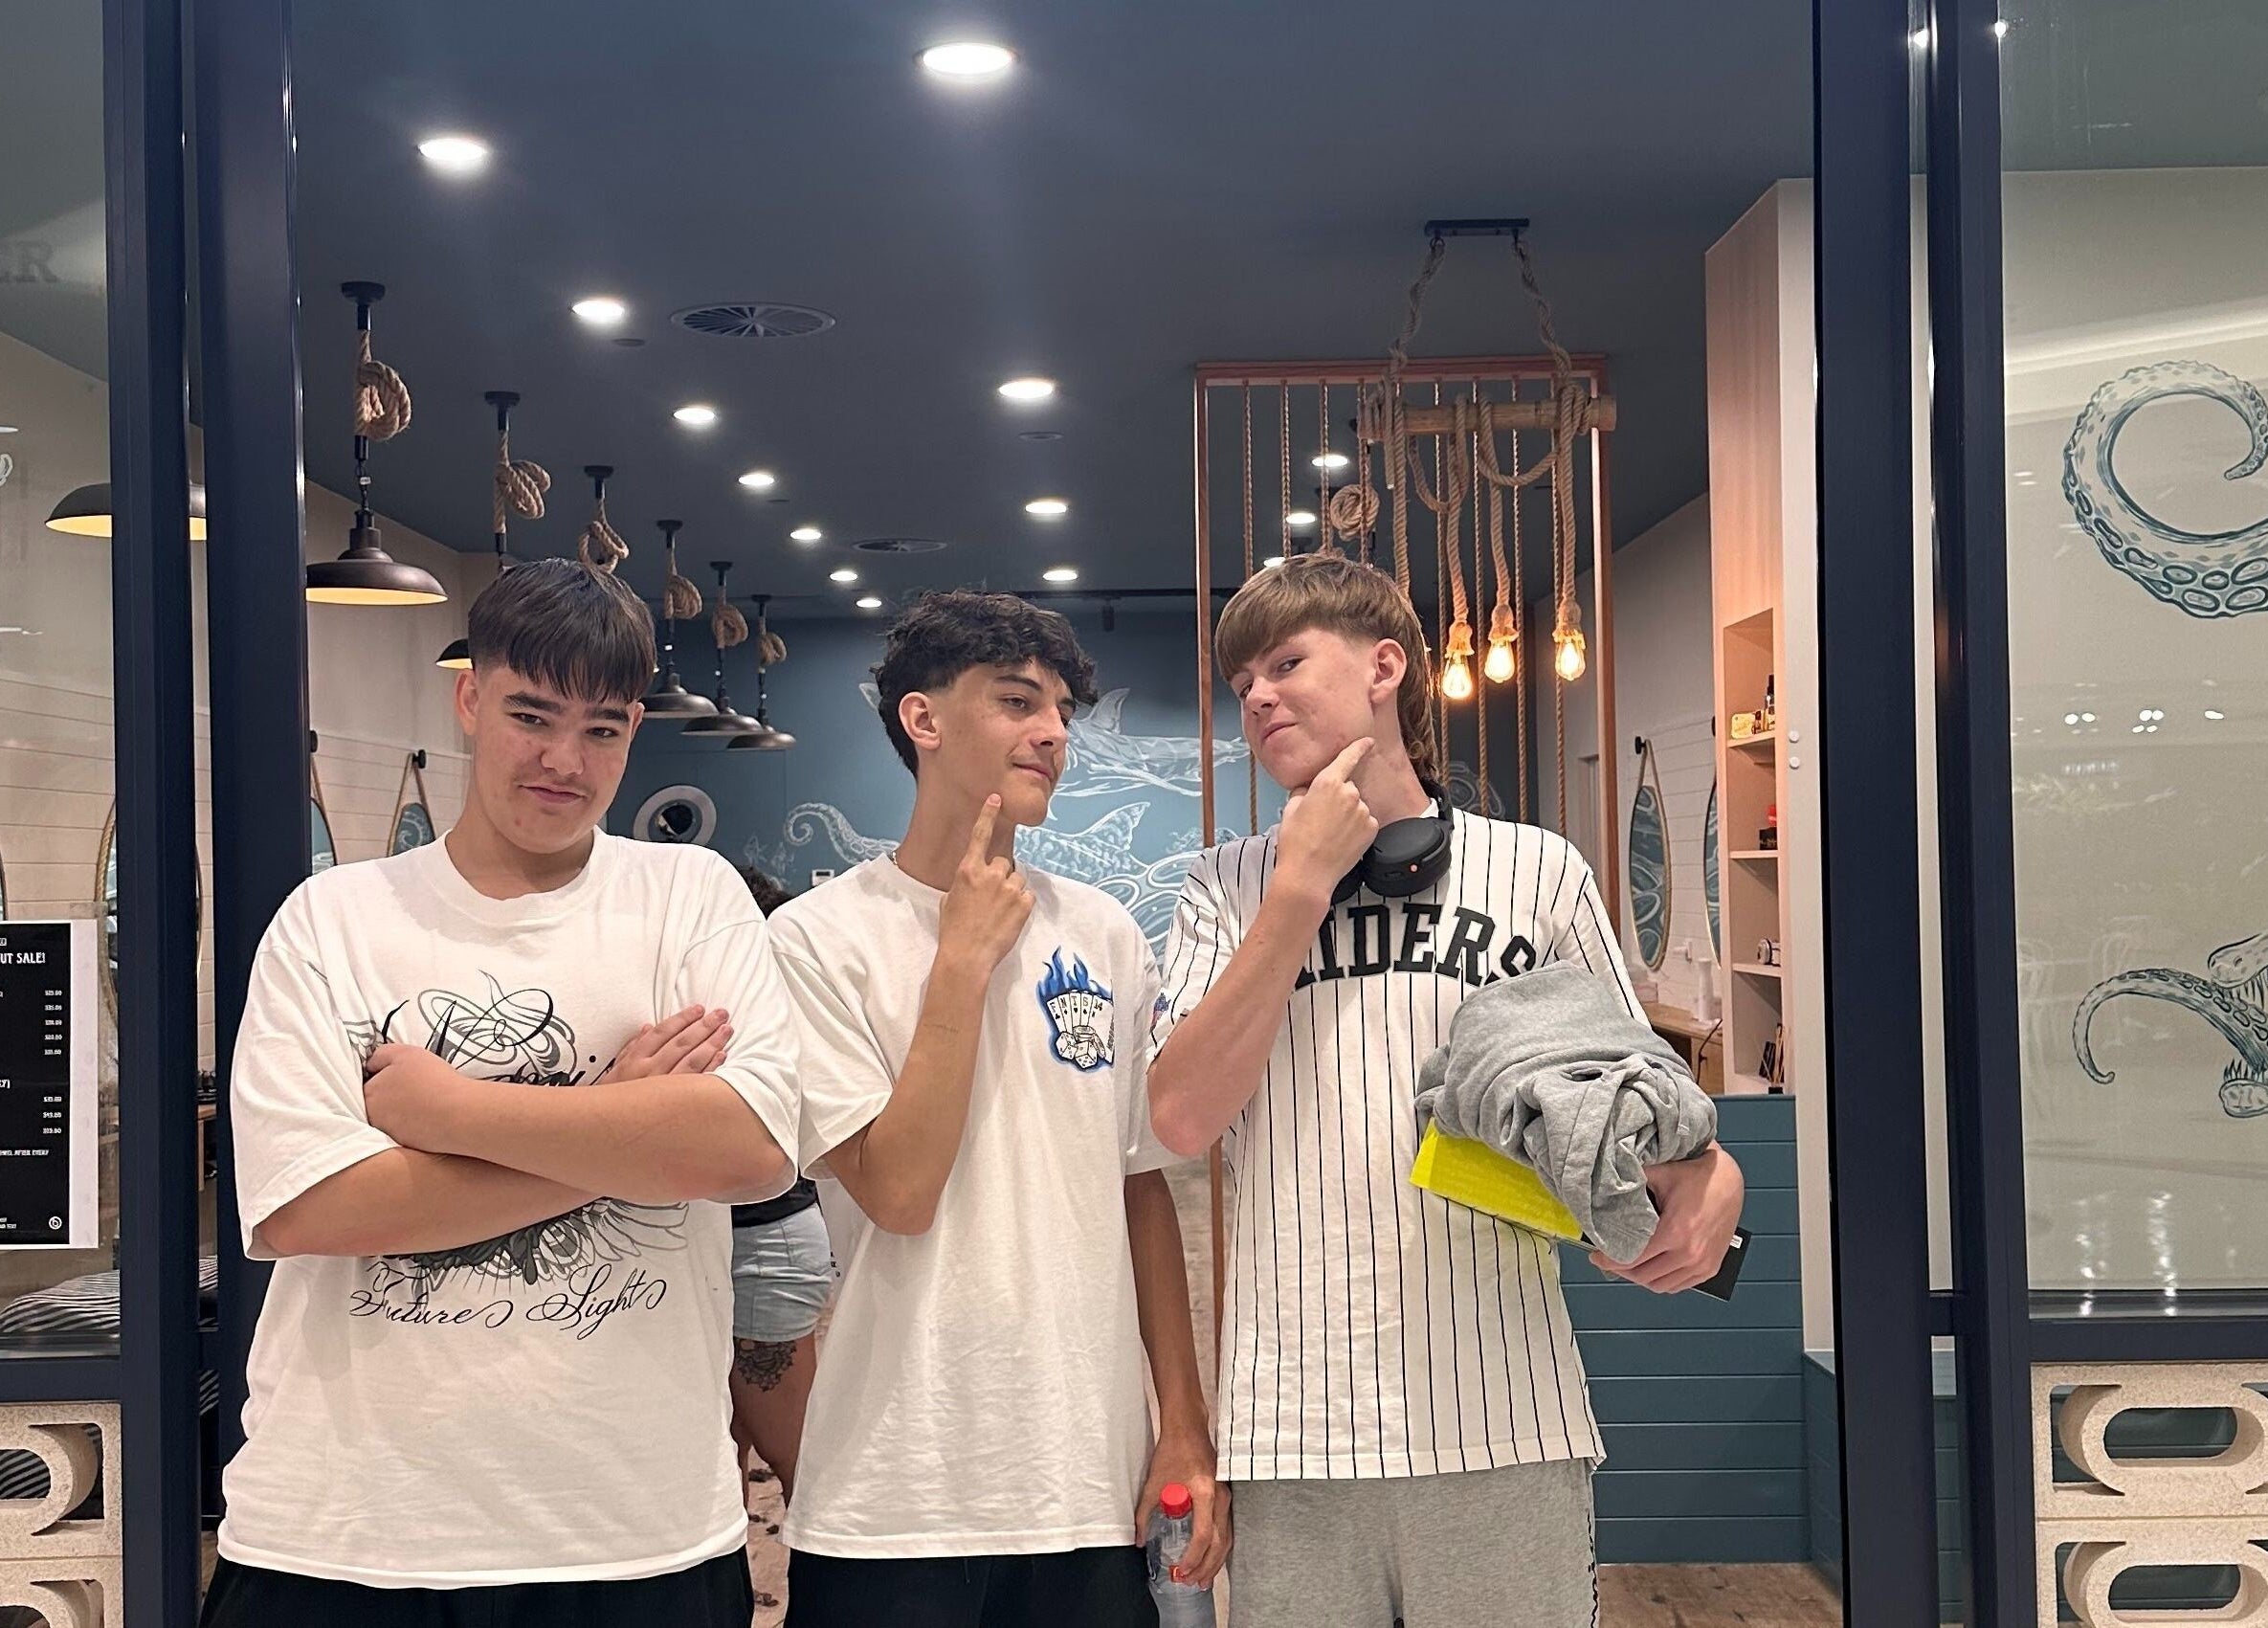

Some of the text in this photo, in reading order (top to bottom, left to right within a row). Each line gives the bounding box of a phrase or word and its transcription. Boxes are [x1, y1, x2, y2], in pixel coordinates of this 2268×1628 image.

[0, 239, 58, 282] R
[0, 952, 46, 964] UT SALE!
[1295, 903, 1537, 991] IDERS
[350, 1261, 514, 1328] Future
